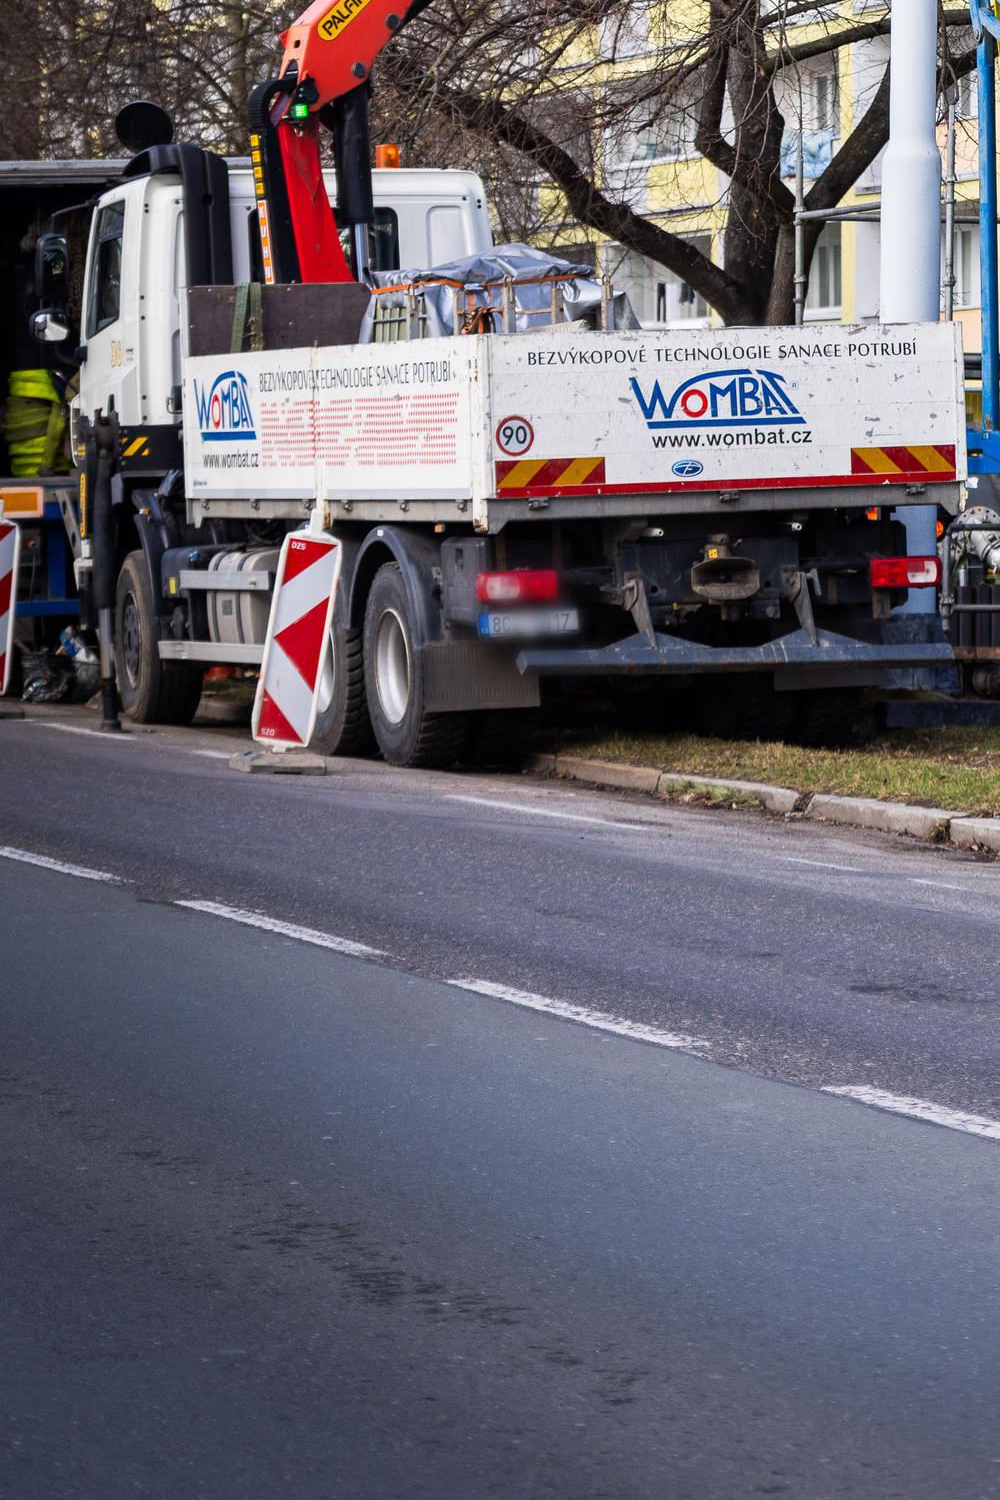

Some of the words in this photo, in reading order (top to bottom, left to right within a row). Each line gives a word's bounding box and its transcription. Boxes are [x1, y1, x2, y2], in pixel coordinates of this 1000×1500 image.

[528, 345, 647, 365] BEZVÝKOPOVÉ
[655, 346, 771, 362] TECHNOLOGIE
[779, 344, 841, 358] SANACE
[848, 338, 917, 357] POTRUBÍ
[376, 363, 410, 386] SANACE
[193, 370, 255, 430] WOMBAT
[629, 368, 800, 420] WOMBAT
[502, 426, 528, 446] 90
[652, 428, 813, 449] www.wombat.cz
[203, 450, 259, 468] www.wombat.cz
[291, 541, 306, 551] DZS
